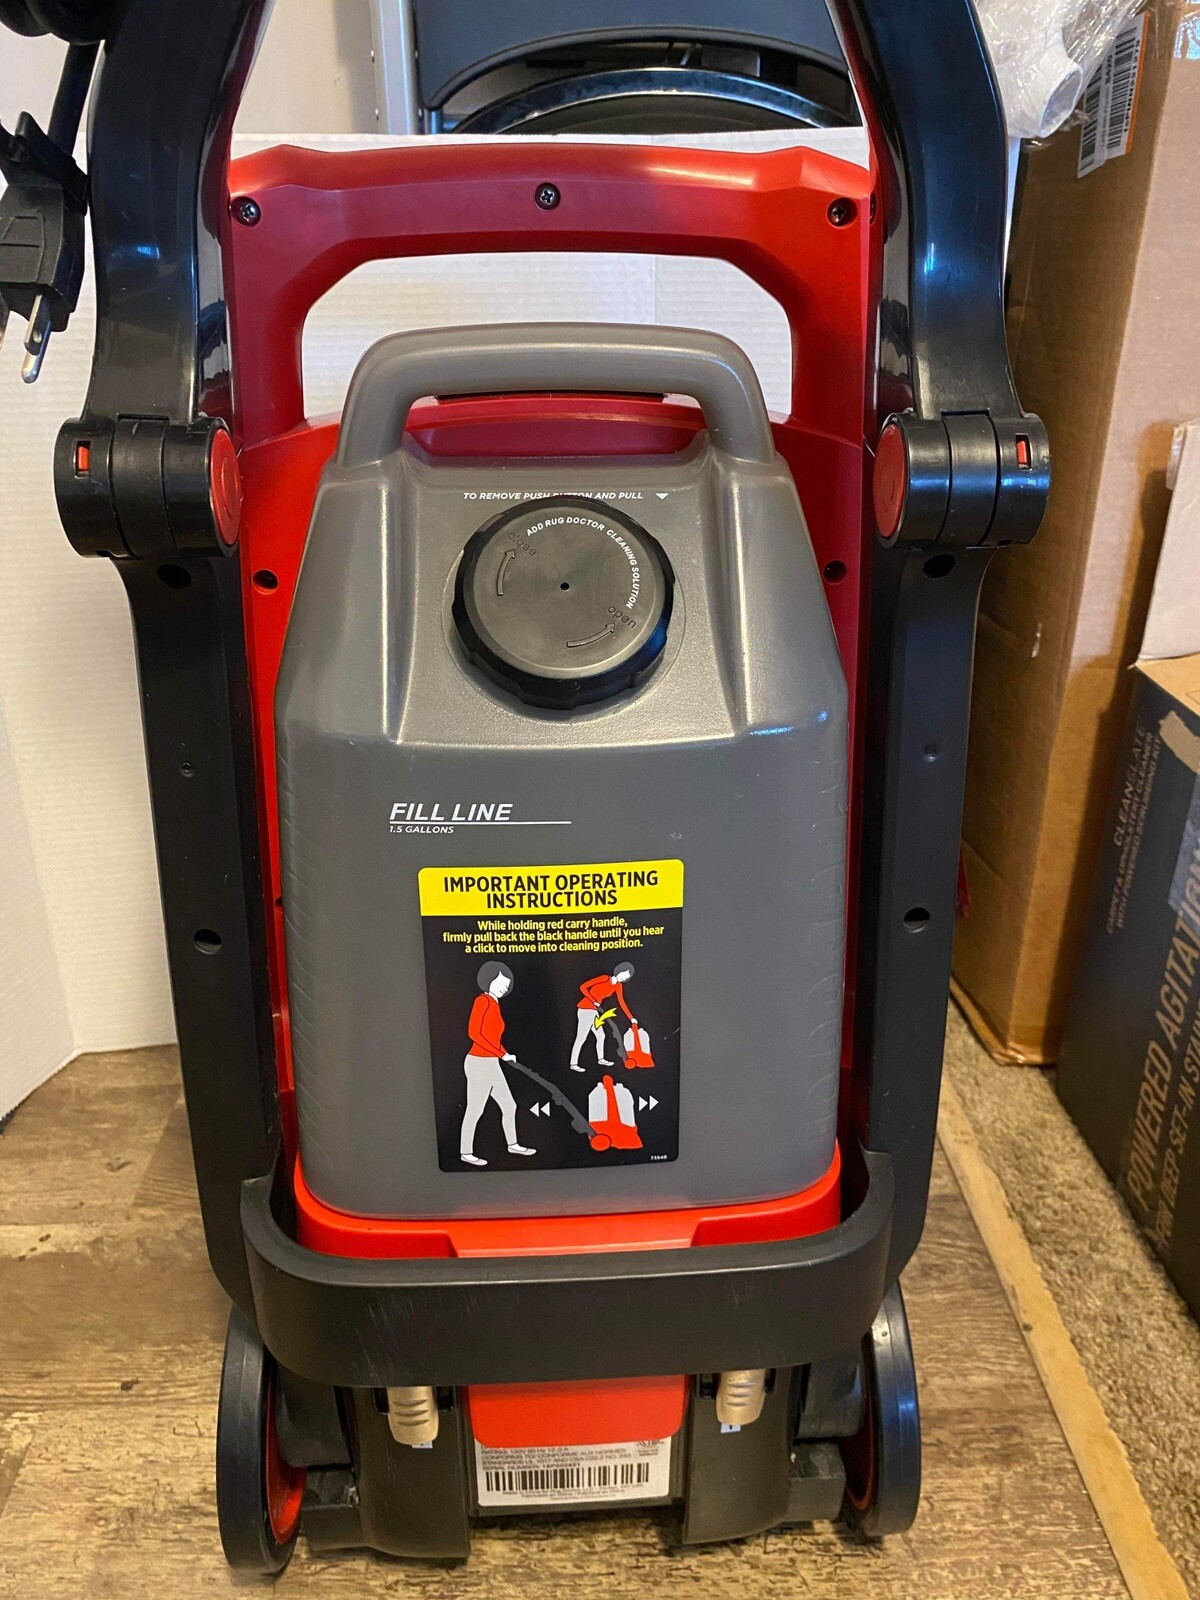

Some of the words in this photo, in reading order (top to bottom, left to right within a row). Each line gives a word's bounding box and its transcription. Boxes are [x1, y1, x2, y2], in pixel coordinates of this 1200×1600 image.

[463, 492, 478, 500] TO
[479, 492, 522, 500] REMOVE
[523, 492, 551, 500] PUSH
[594, 492, 617, 500] AND
[618, 491, 643, 500] PULL
[507, 533, 537, 556] close
[526, 523, 544, 537] ADD
[545, 517, 565, 527] RUG
[566, 516, 605, 531] DOCTOR
[606, 529, 638, 566] CLEANING
[625, 566, 640, 610] SOLUTION
[389, 803, 446, 821] FILL
[451, 803, 513, 821] LINE
[389, 825, 403, 833] 1.5
[405, 825, 455, 834] GALLONS
[444, 875, 550, 892] IMPORTANT
[555, 870, 658, 890] OPERATING
[487, 890, 617, 909] INSTRUCTIONS
[477, 920, 506, 931] While
[508, 919, 546, 931] holding
[547, 919, 564, 929] red
[565, 920, 590, 930] carry
[592, 916, 628, 928] handle,
[442, 932, 472, 944] firmly
[474, 931, 492, 943] pull
[494, 931, 517, 942] back
[519, 931, 536, 941] the
[537, 930, 563, 941] black
[565, 929, 598, 940] handle
[599, 928, 621, 939] until
[623, 928, 641, 938] you
[643, 925, 665, 936] hear
[465, 945, 472, 953] a
[473, 943, 495, 953] click
[496, 943, 507, 953] to
[508, 944, 536, 953] move
[538, 942, 557, 952] into
[559, 940, 600, 952] cleaning
[601, 938, 643, 951] position.
[1168, 1075, 1196, 1155] SET-IN
[1127, 1040, 1172, 1213] POWERED
[1160, 1148, 1180, 1209] DEEP
